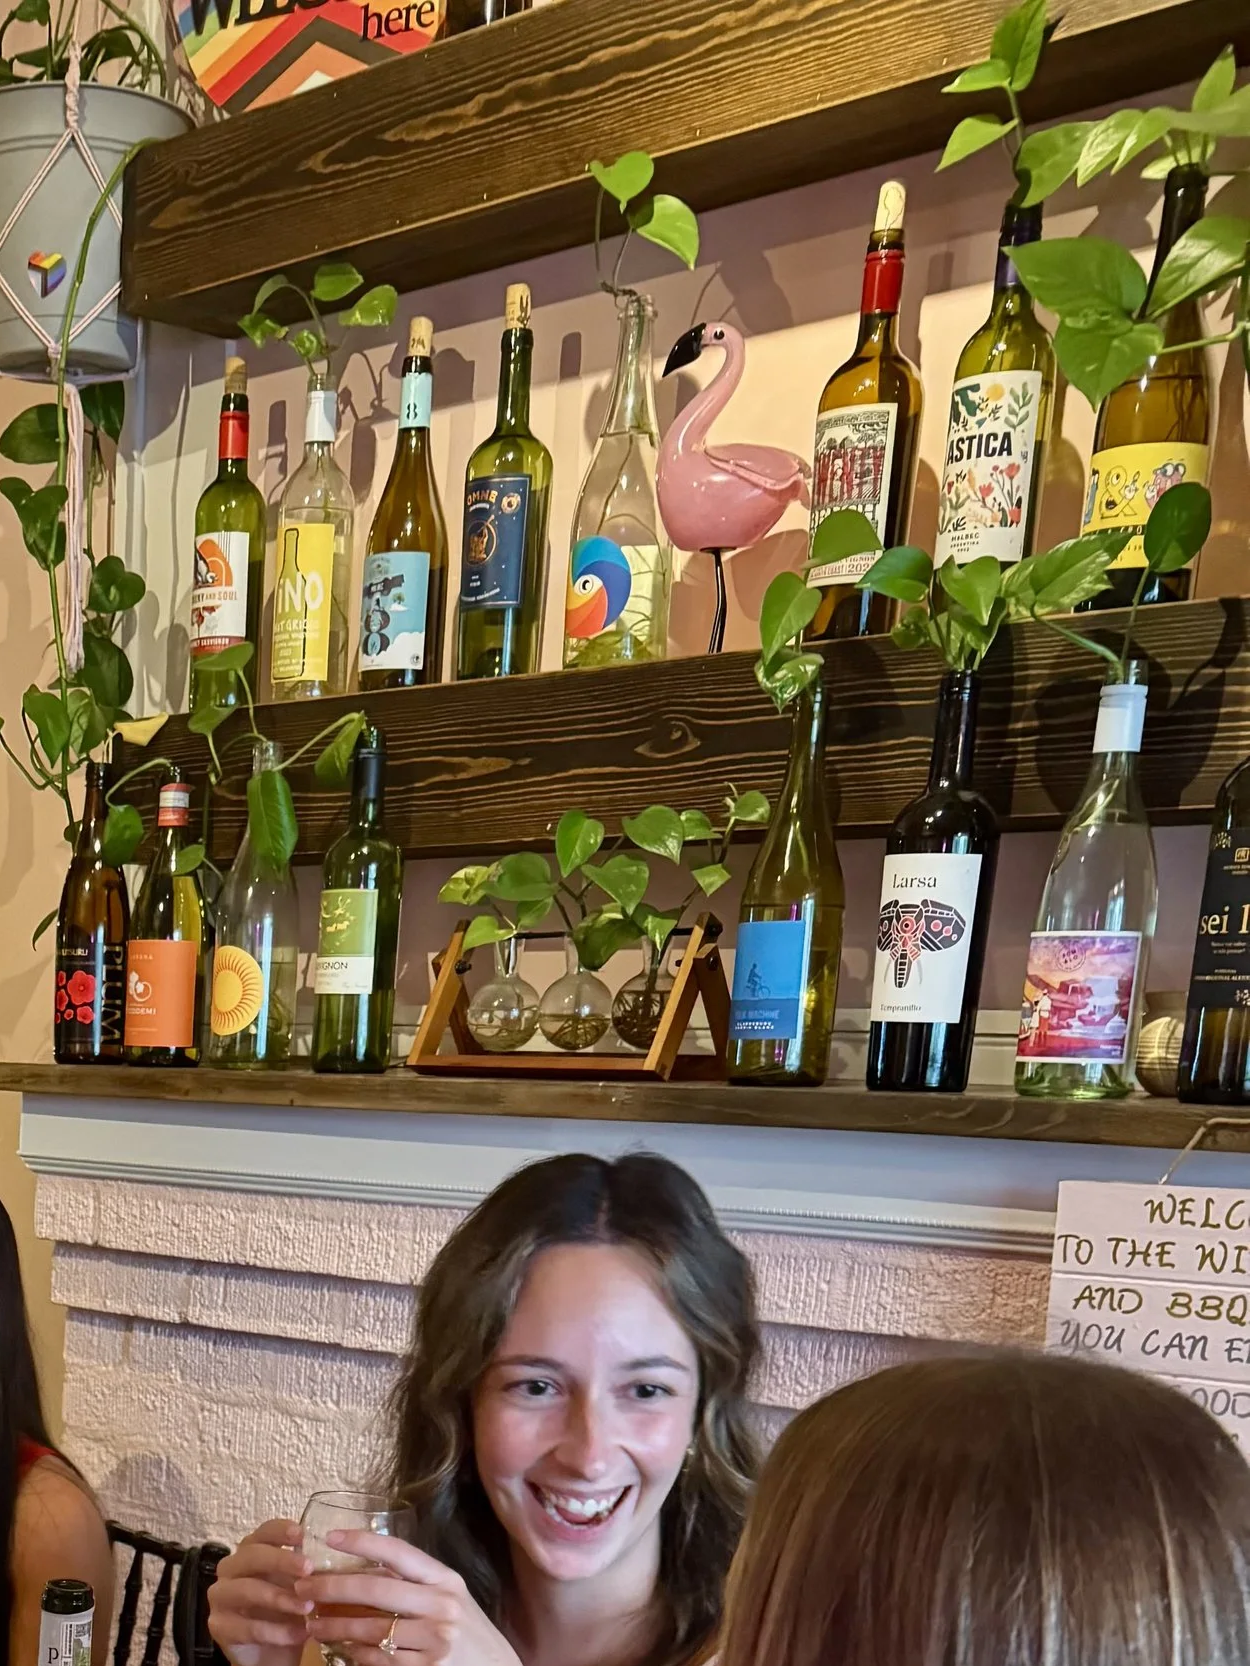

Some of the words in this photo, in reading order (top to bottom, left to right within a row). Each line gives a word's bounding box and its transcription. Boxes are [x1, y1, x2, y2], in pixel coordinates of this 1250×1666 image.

[361, 0, 435, 42] here
[951, 532, 980, 542] MALBEC
[217, 591, 238, 601] SOUL
[1200, 906, 1230, 935] sei
[1144, 1193, 1250, 1230] WELC
[1058, 1234, 1094, 1265] TO
[1107, 1237, 1176, 1268] THE
[1072, 1284, 1143, 1314] AND
[1060, 1320, 1125, 1354] YOU
[1140, 1328, 1209, 1361] CAN
[1224, 1337, 1250, 1364] E
[48, 1647, 59, 1664] p
